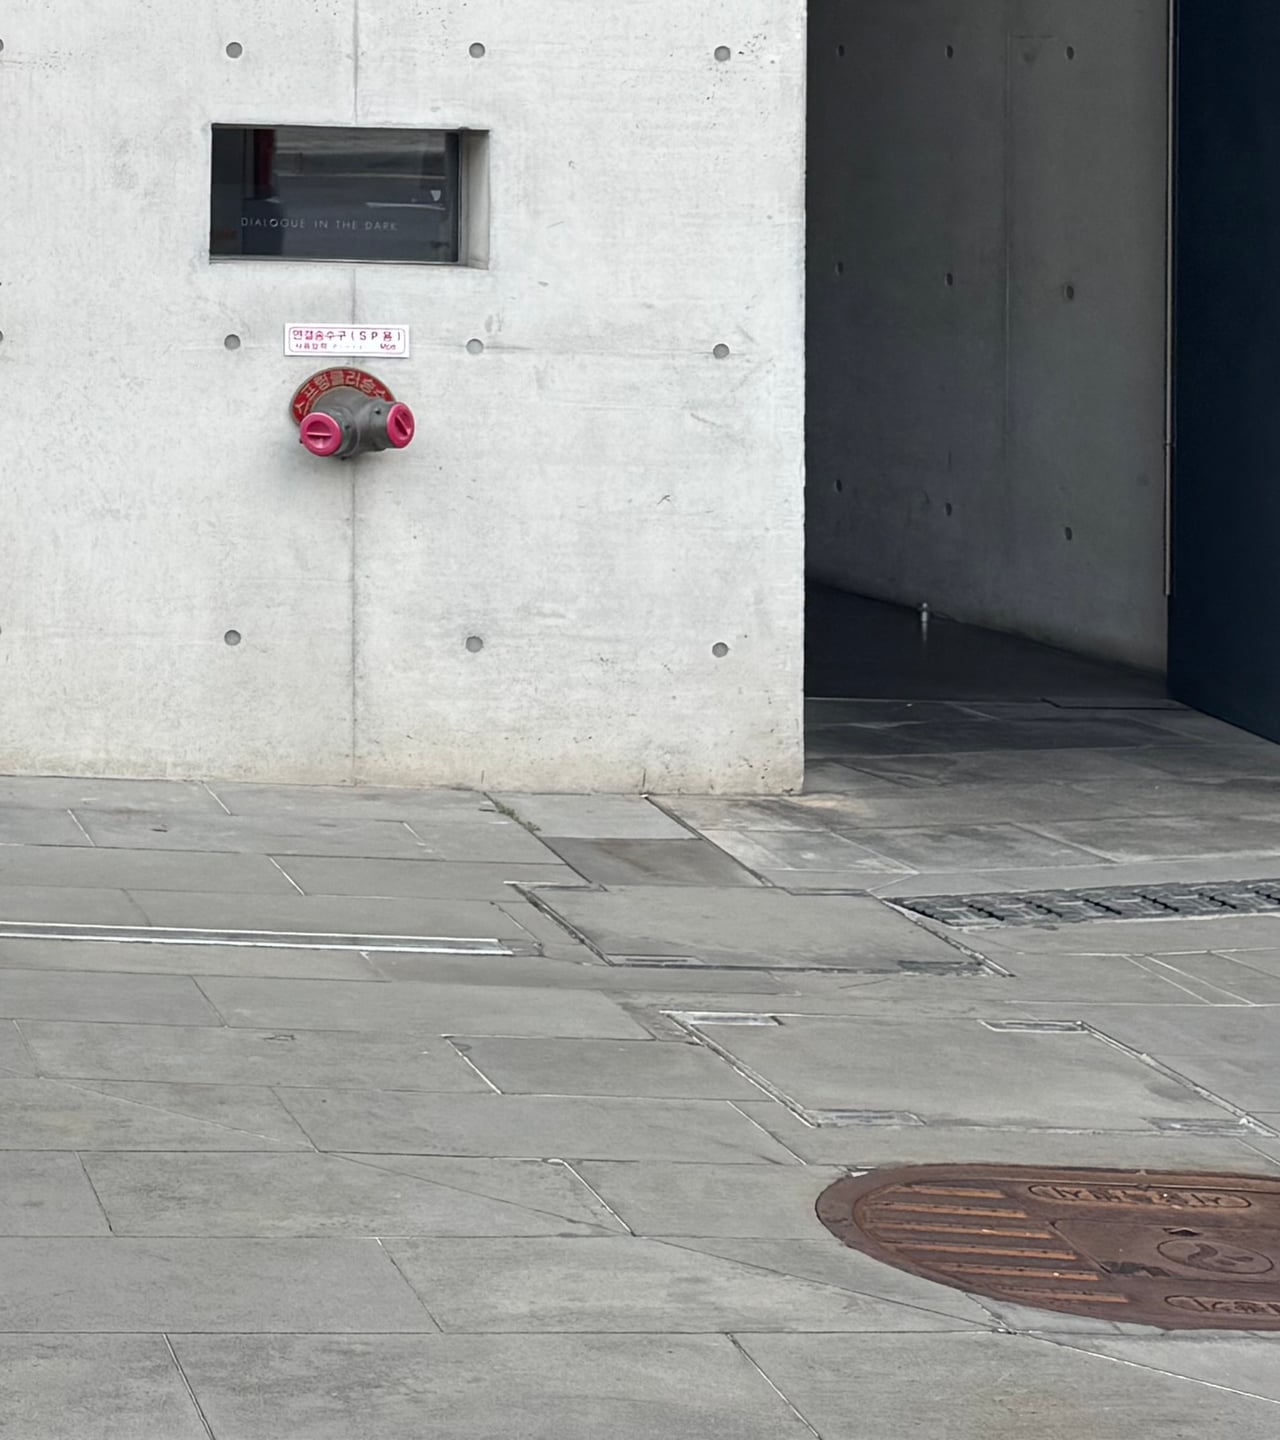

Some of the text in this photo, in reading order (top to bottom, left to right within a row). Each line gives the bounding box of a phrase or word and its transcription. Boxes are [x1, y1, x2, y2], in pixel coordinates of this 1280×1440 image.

[240, 217, 398, 231] DIALOGUE IN THE DARK
